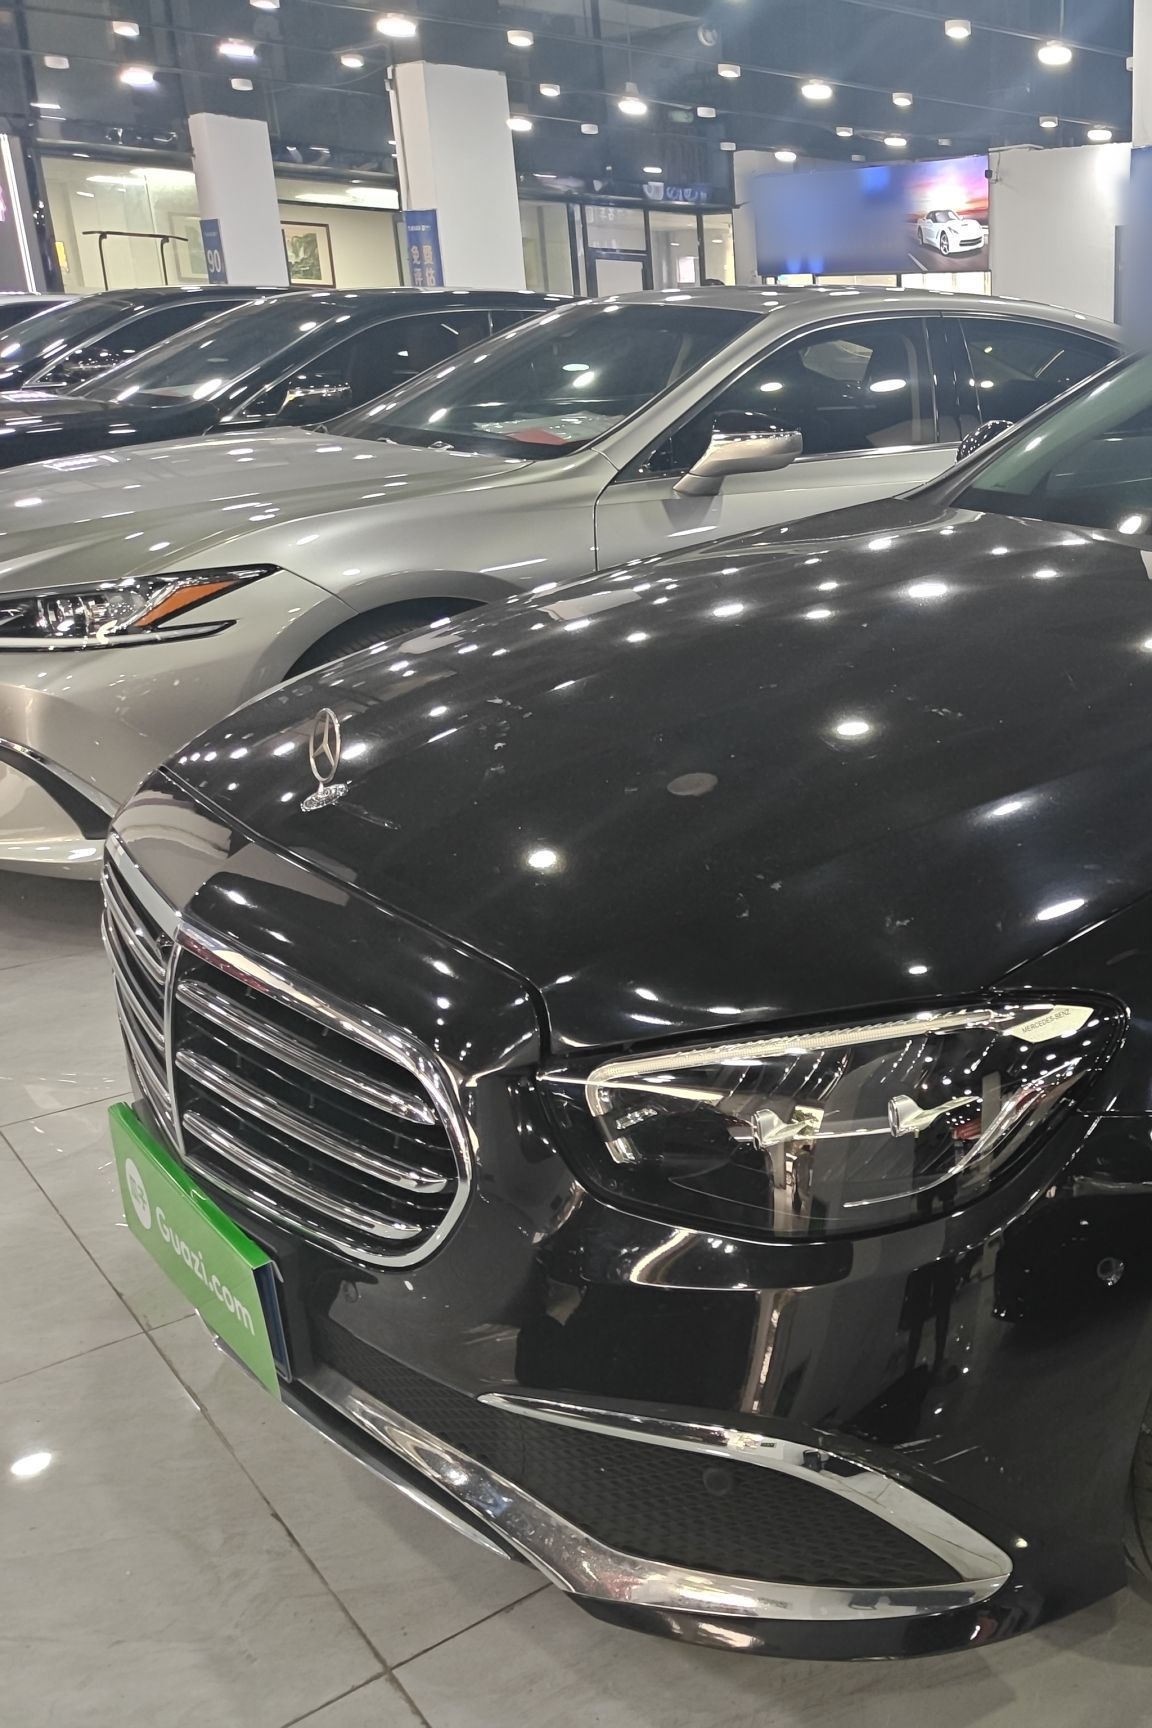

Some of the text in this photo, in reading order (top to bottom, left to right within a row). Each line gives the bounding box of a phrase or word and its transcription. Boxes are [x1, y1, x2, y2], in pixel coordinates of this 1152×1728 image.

[207, 249, 222, 273] 90
[1021, 1008, 1072, 1034] MERCEDES-BENZ
[155, 1205, 256, 1337] Guazi.com
